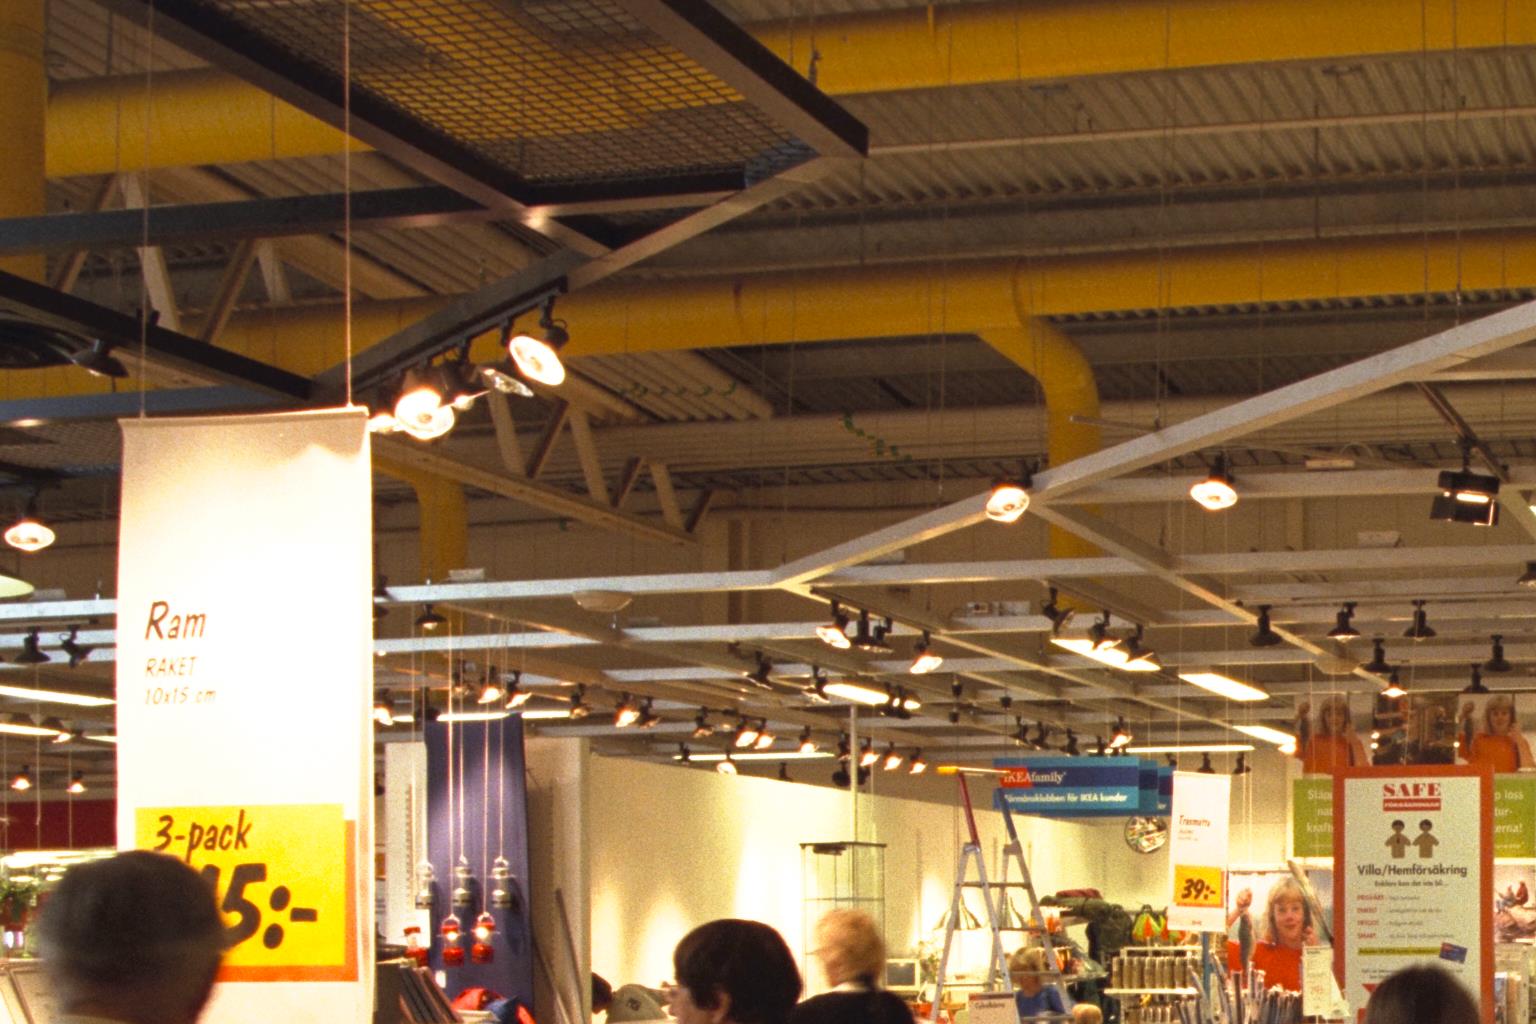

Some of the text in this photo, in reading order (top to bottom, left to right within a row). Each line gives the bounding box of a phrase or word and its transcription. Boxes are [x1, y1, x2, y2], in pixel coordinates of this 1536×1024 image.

[145, 600, 206, 640] Ram
[145, 656, 198, 677] RAKET
[196, 690, 216, 704] cm
[1383, 783, 1441, 796] SAFE
[154, 809, 252, 863] 3-pack
[1181, 878, 1216, 900] 39:-
